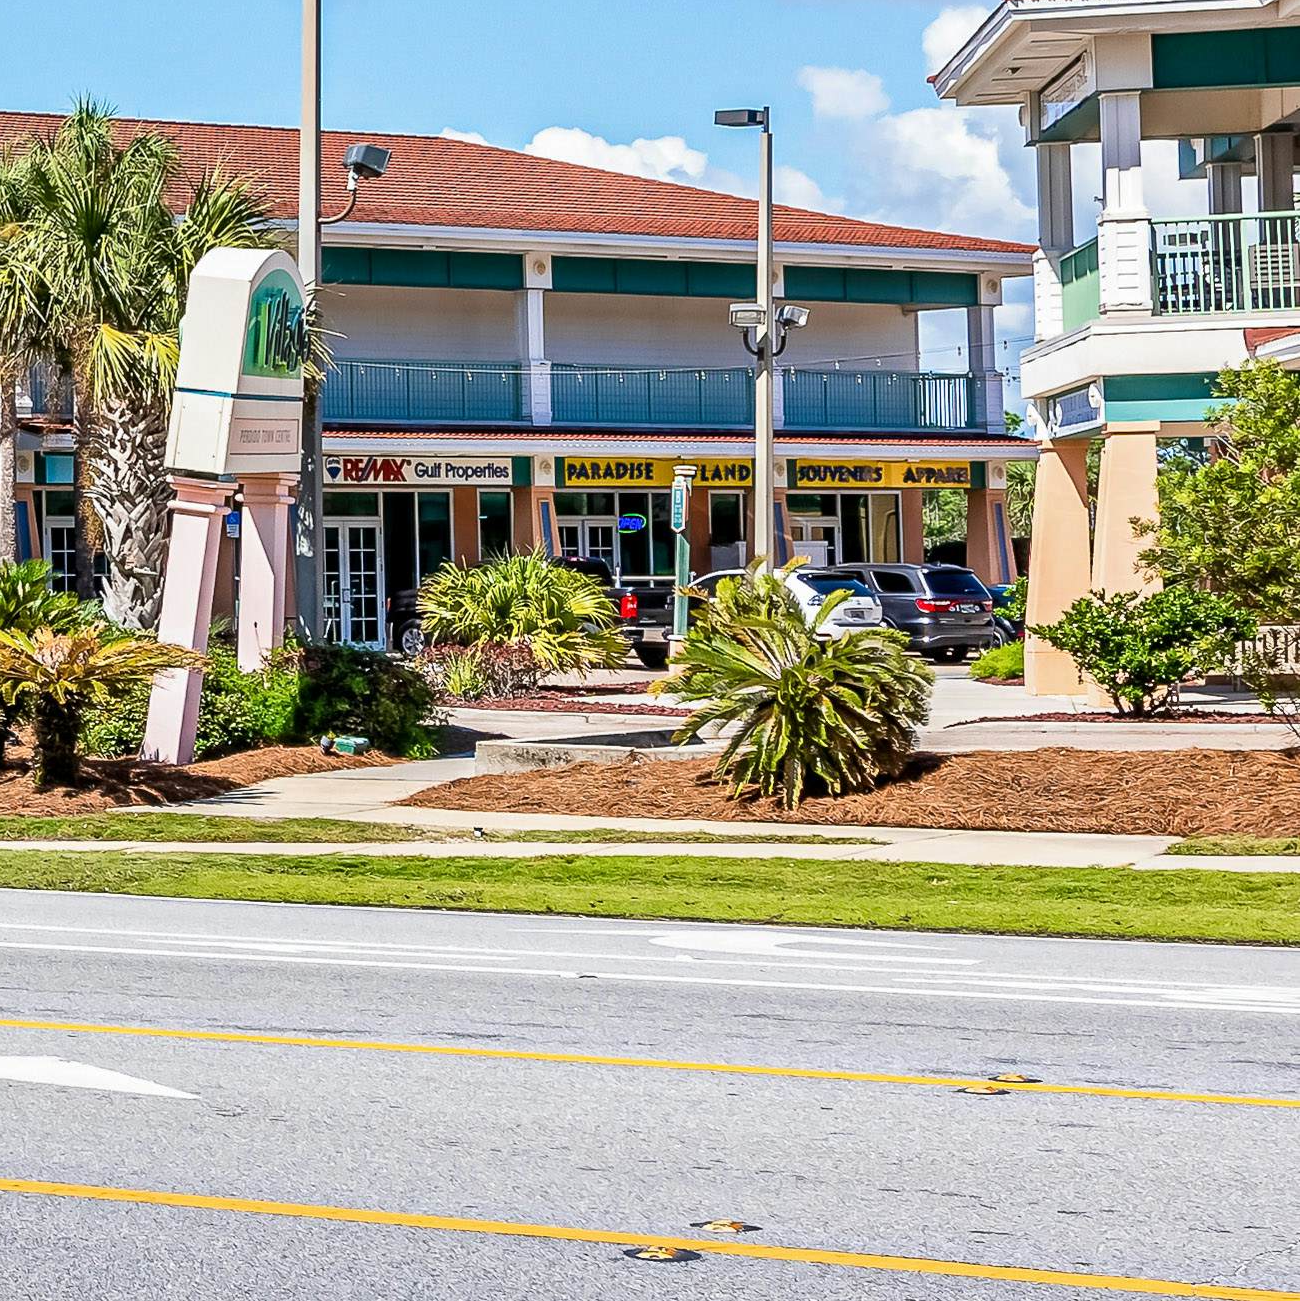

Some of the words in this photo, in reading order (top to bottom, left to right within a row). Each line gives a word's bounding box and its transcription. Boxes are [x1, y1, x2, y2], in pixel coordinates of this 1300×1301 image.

[414, 462, 442, 479] Gulf
[445, 462, 509, 481] Properties
[567, 462, 654, 481] PARADISE
[618, 517, 643, 531] OPEN
